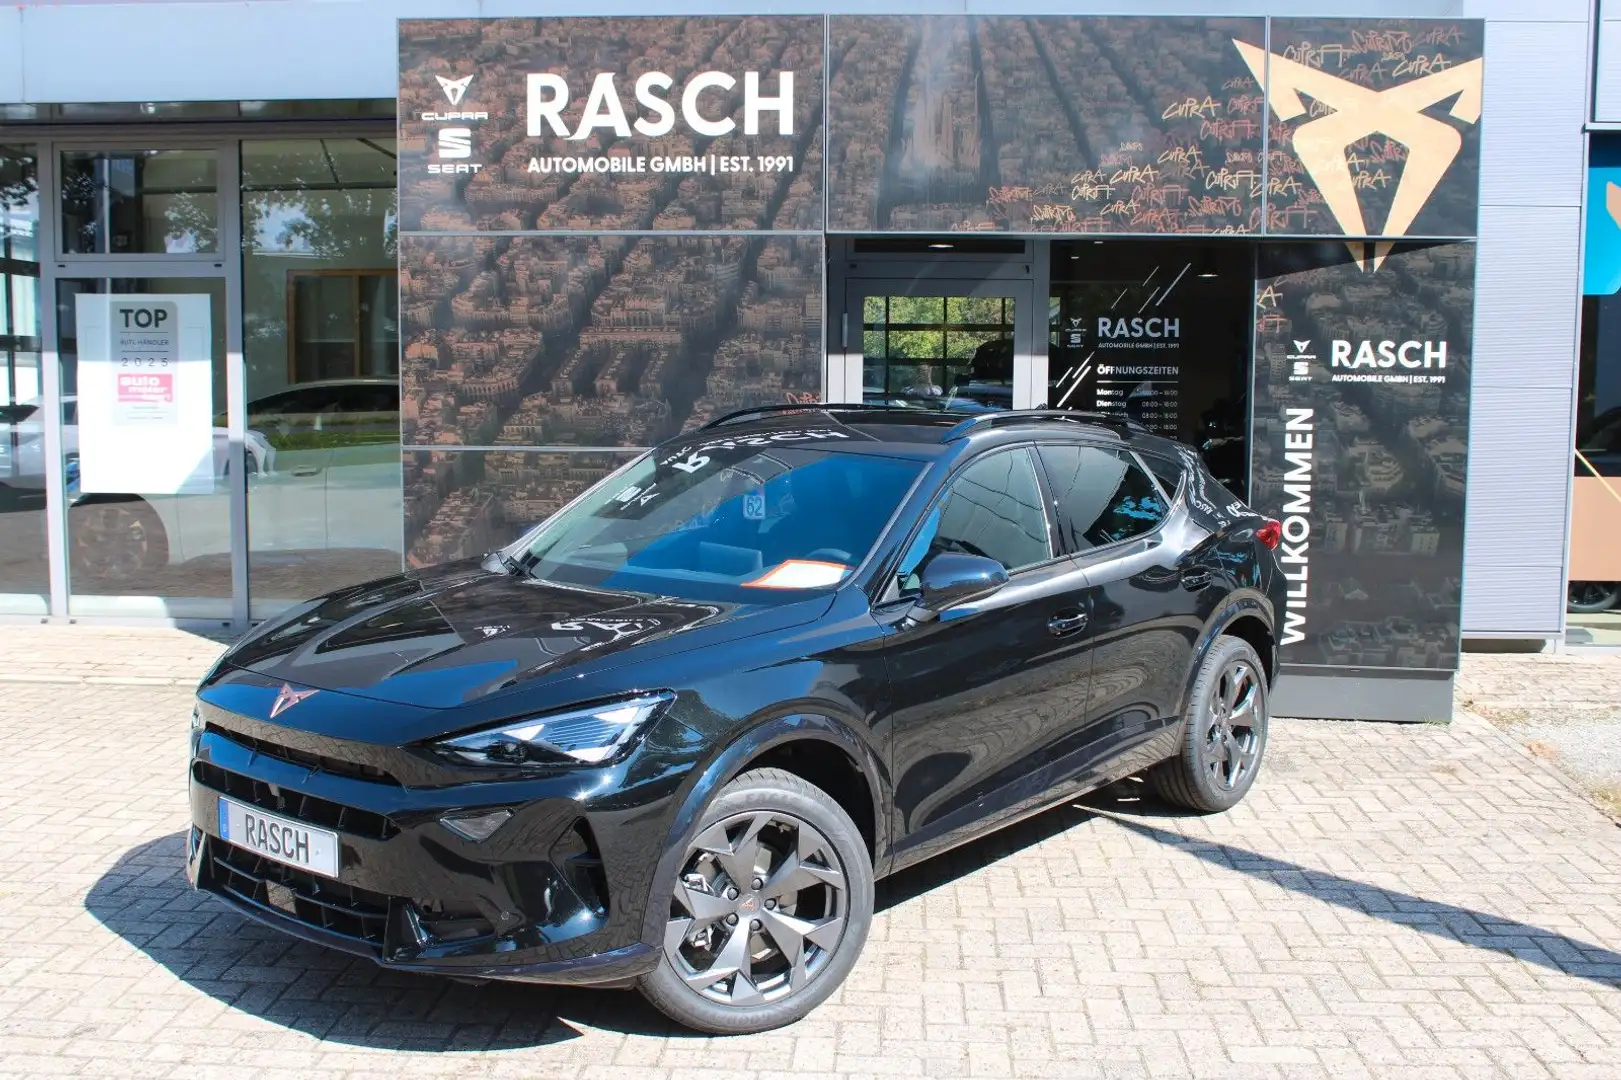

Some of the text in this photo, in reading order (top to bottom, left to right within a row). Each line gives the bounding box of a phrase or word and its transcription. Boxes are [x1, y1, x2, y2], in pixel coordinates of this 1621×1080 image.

[527, 71, 794, 141] RASCH
[421, 111, 488, 121] CUPRA
[427, 164, 482, 174] SEAT
[527, 156, 646, 173] AUTOMOBILE
[650, 156, 706, 173] GMBH
[720, 156, 753, 173] EST.
[757, 156, 793, 172] 1991
[119, 308, 168, 328] TOP
[1098, 317, 1180, 339] RASCH
[1331, 339, 1447, 369] RASCH
[122, 357, 169, 367] 2025
[1097, 364, 1179, 375] ÖFFNUNGSZEITEN
[120, 376, 160, 386] auto
[1331, 374, 1382, 383] AUTOMOBILE
[1383, 375, 1409, 383] GMBH
[1414, 376, 1428, 384] EST.
[1430, 376, 1446, 384] 1991
[1096, 388, 1124, 397] Montag
[1096, 400, 1127, 408] Dienstag
[746, 496, 763, 517] 62
[1280, 408, 1314, 646] WILLKOMMEN
[245, 813, 309, 864] RASCH
